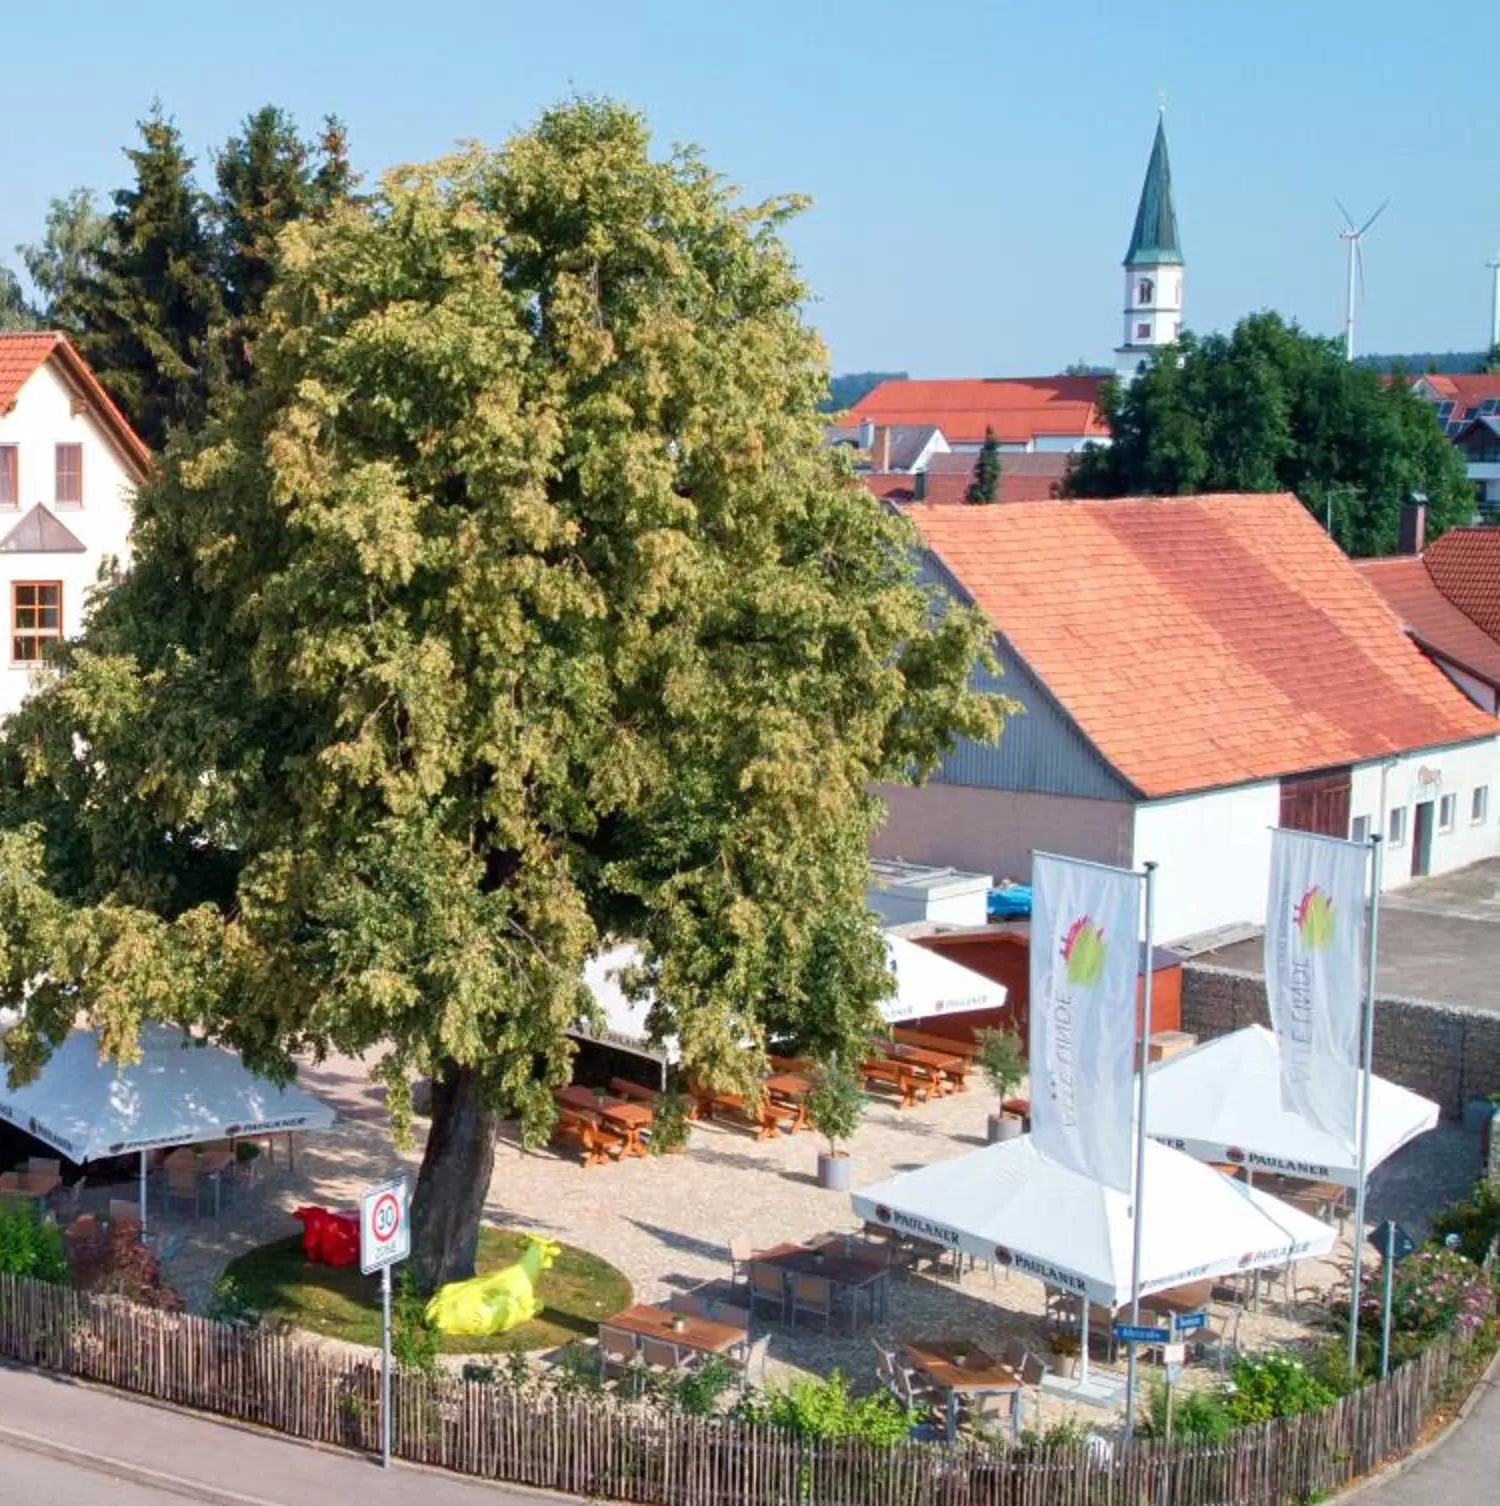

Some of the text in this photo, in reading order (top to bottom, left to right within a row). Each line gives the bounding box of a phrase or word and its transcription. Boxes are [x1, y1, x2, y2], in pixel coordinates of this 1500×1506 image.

[1249, 1151, 1330, 1177] PAULANER
[377, 1205, 395, 1231] 30
[893, 1210, 961, 1246] PAULANER
[1015, 1254, 1087, 1291] PAULANER
